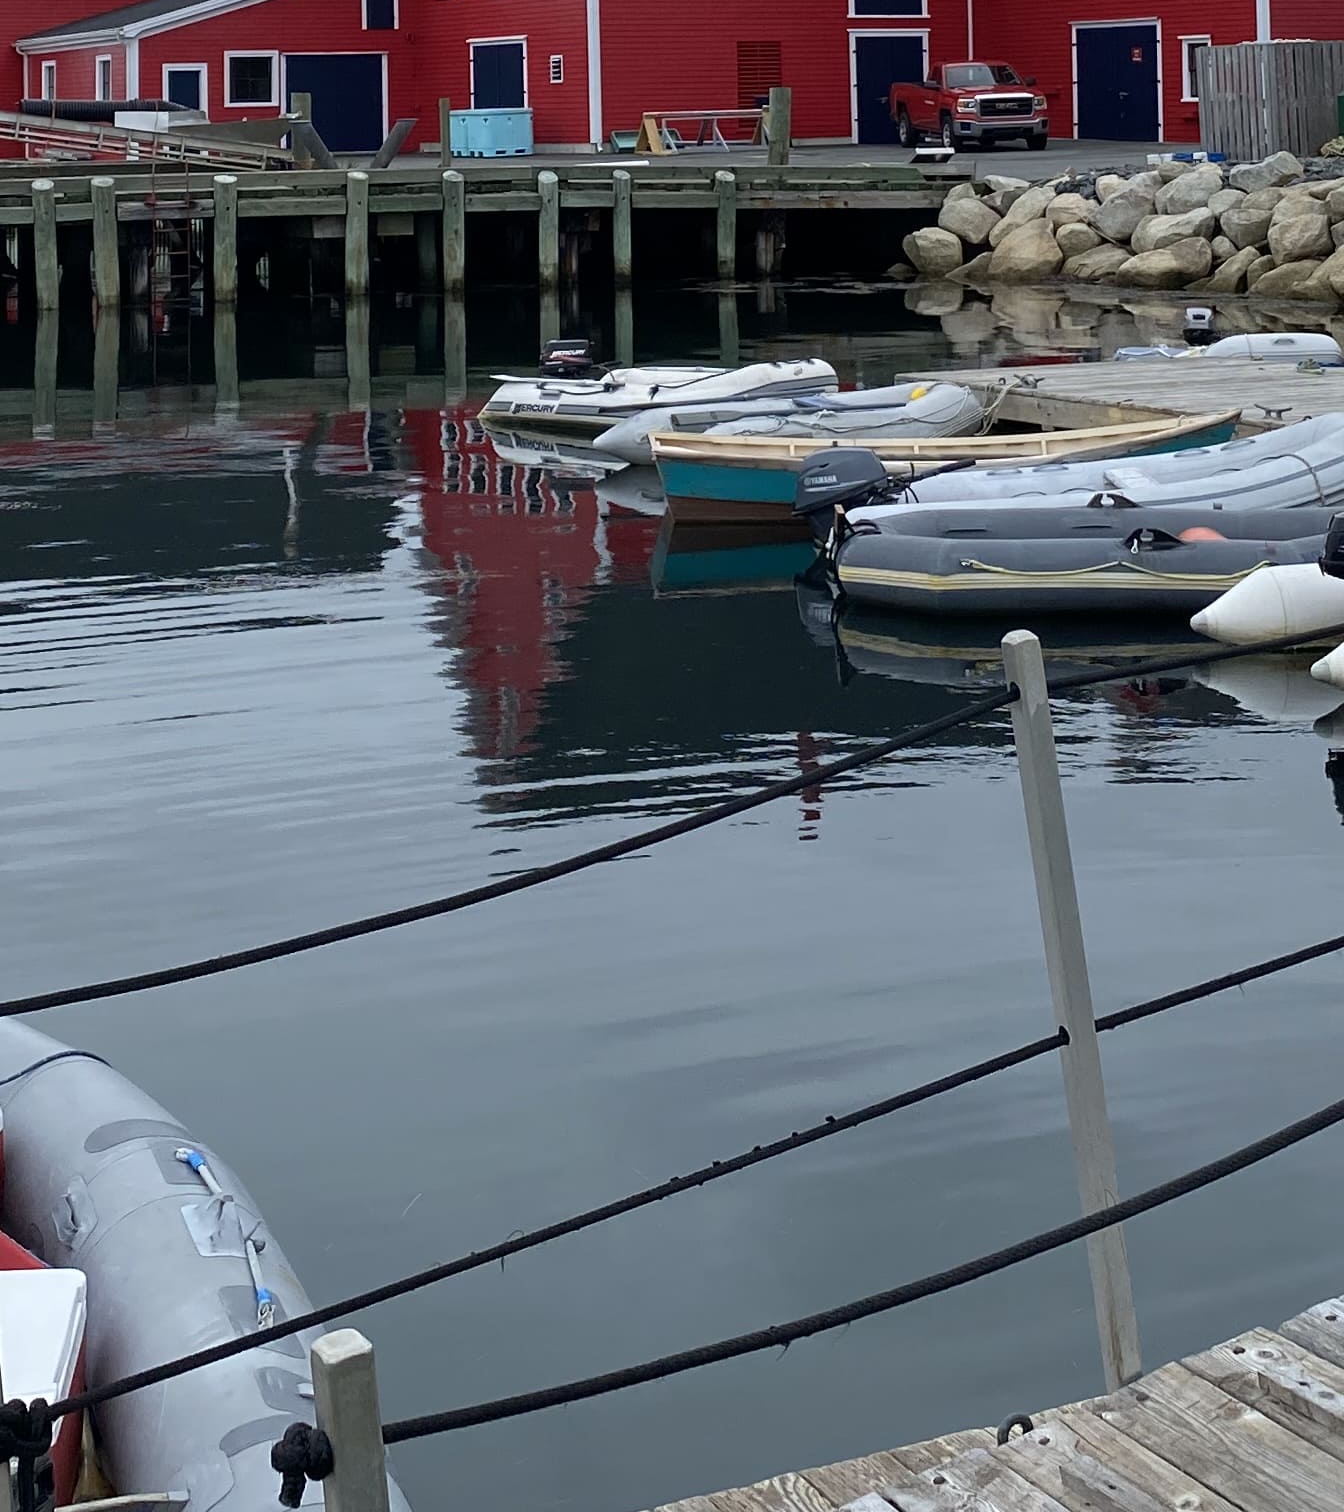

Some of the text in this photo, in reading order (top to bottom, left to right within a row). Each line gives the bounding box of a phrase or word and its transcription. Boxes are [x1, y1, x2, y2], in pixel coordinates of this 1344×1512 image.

[549, 349, 587, 359] MERCURY
[511, 402, 555, 415] MERCURY
[810, 475, 838, 485] YAMAHA
